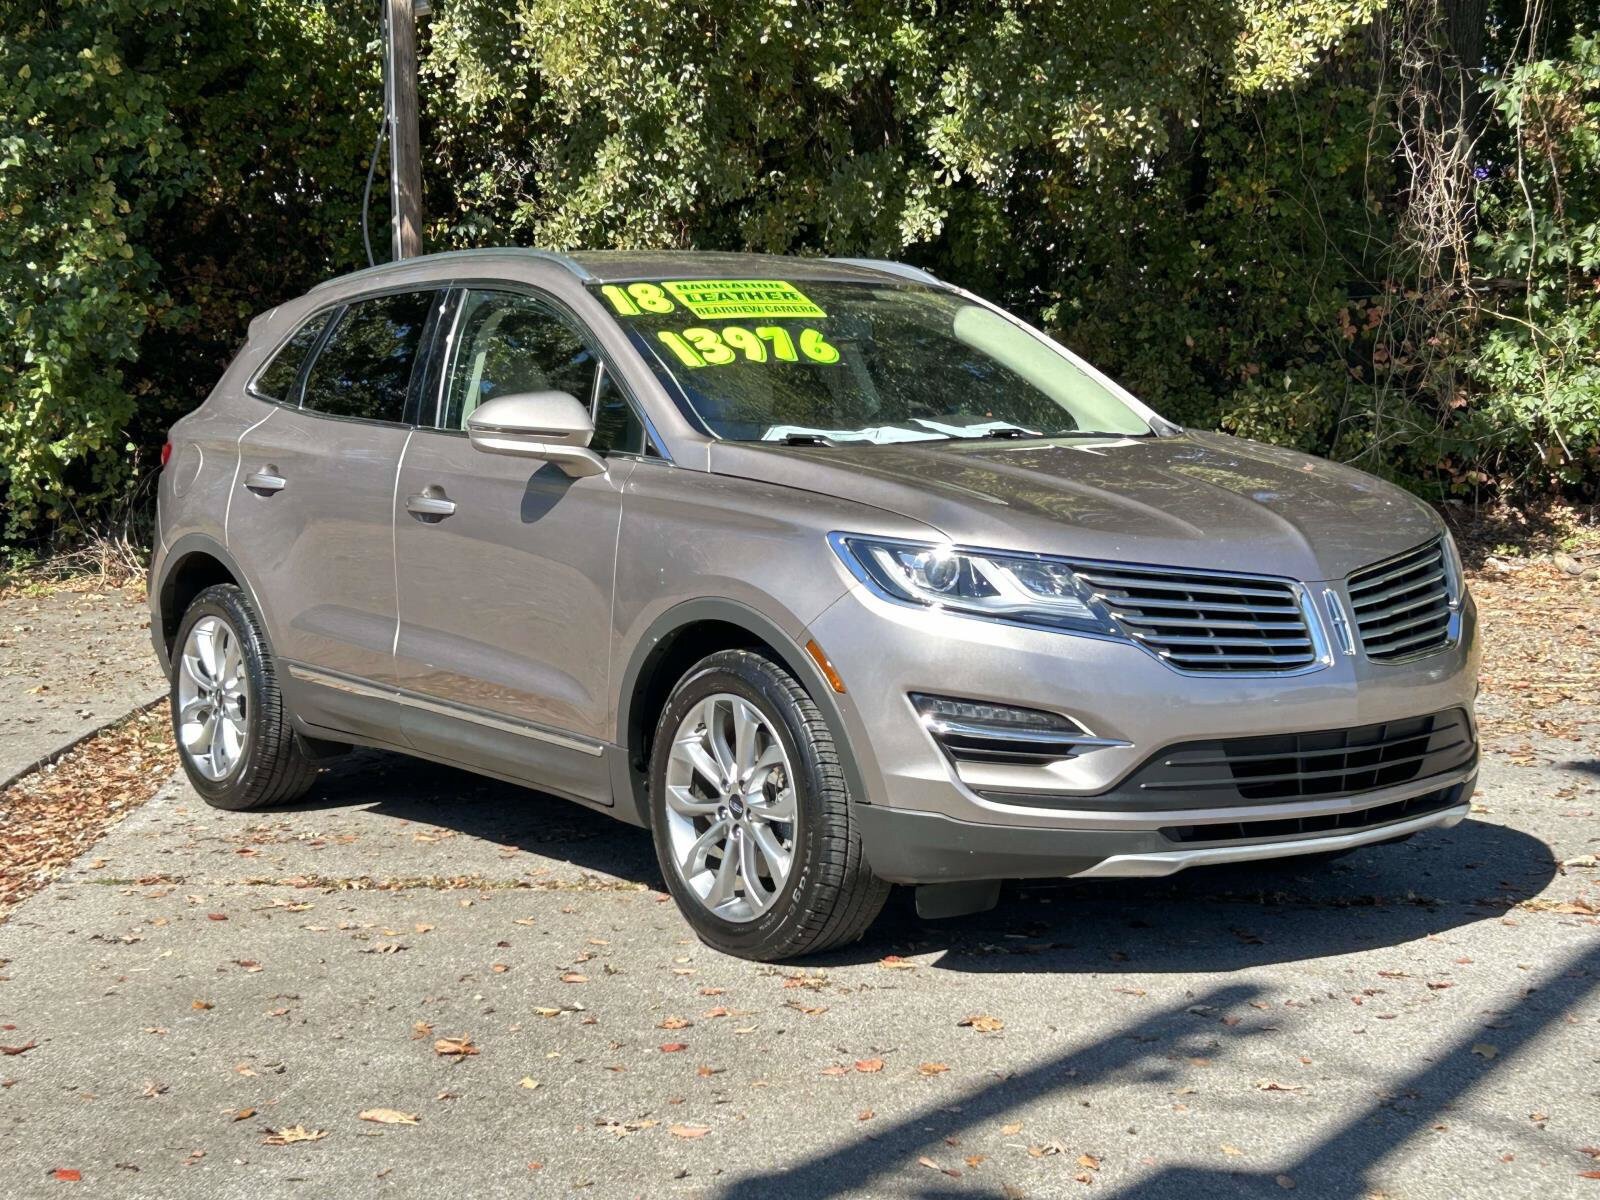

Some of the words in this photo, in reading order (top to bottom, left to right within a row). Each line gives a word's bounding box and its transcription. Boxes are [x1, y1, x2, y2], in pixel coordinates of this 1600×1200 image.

[601, 283, 675, 316] 18
[685, 291, 802, 302] LEATHER
[696, 306, 765, 314] REARVIEW
[765, 305, 819, 313] CAMERA
[658, 327, 840, 367] 13976
